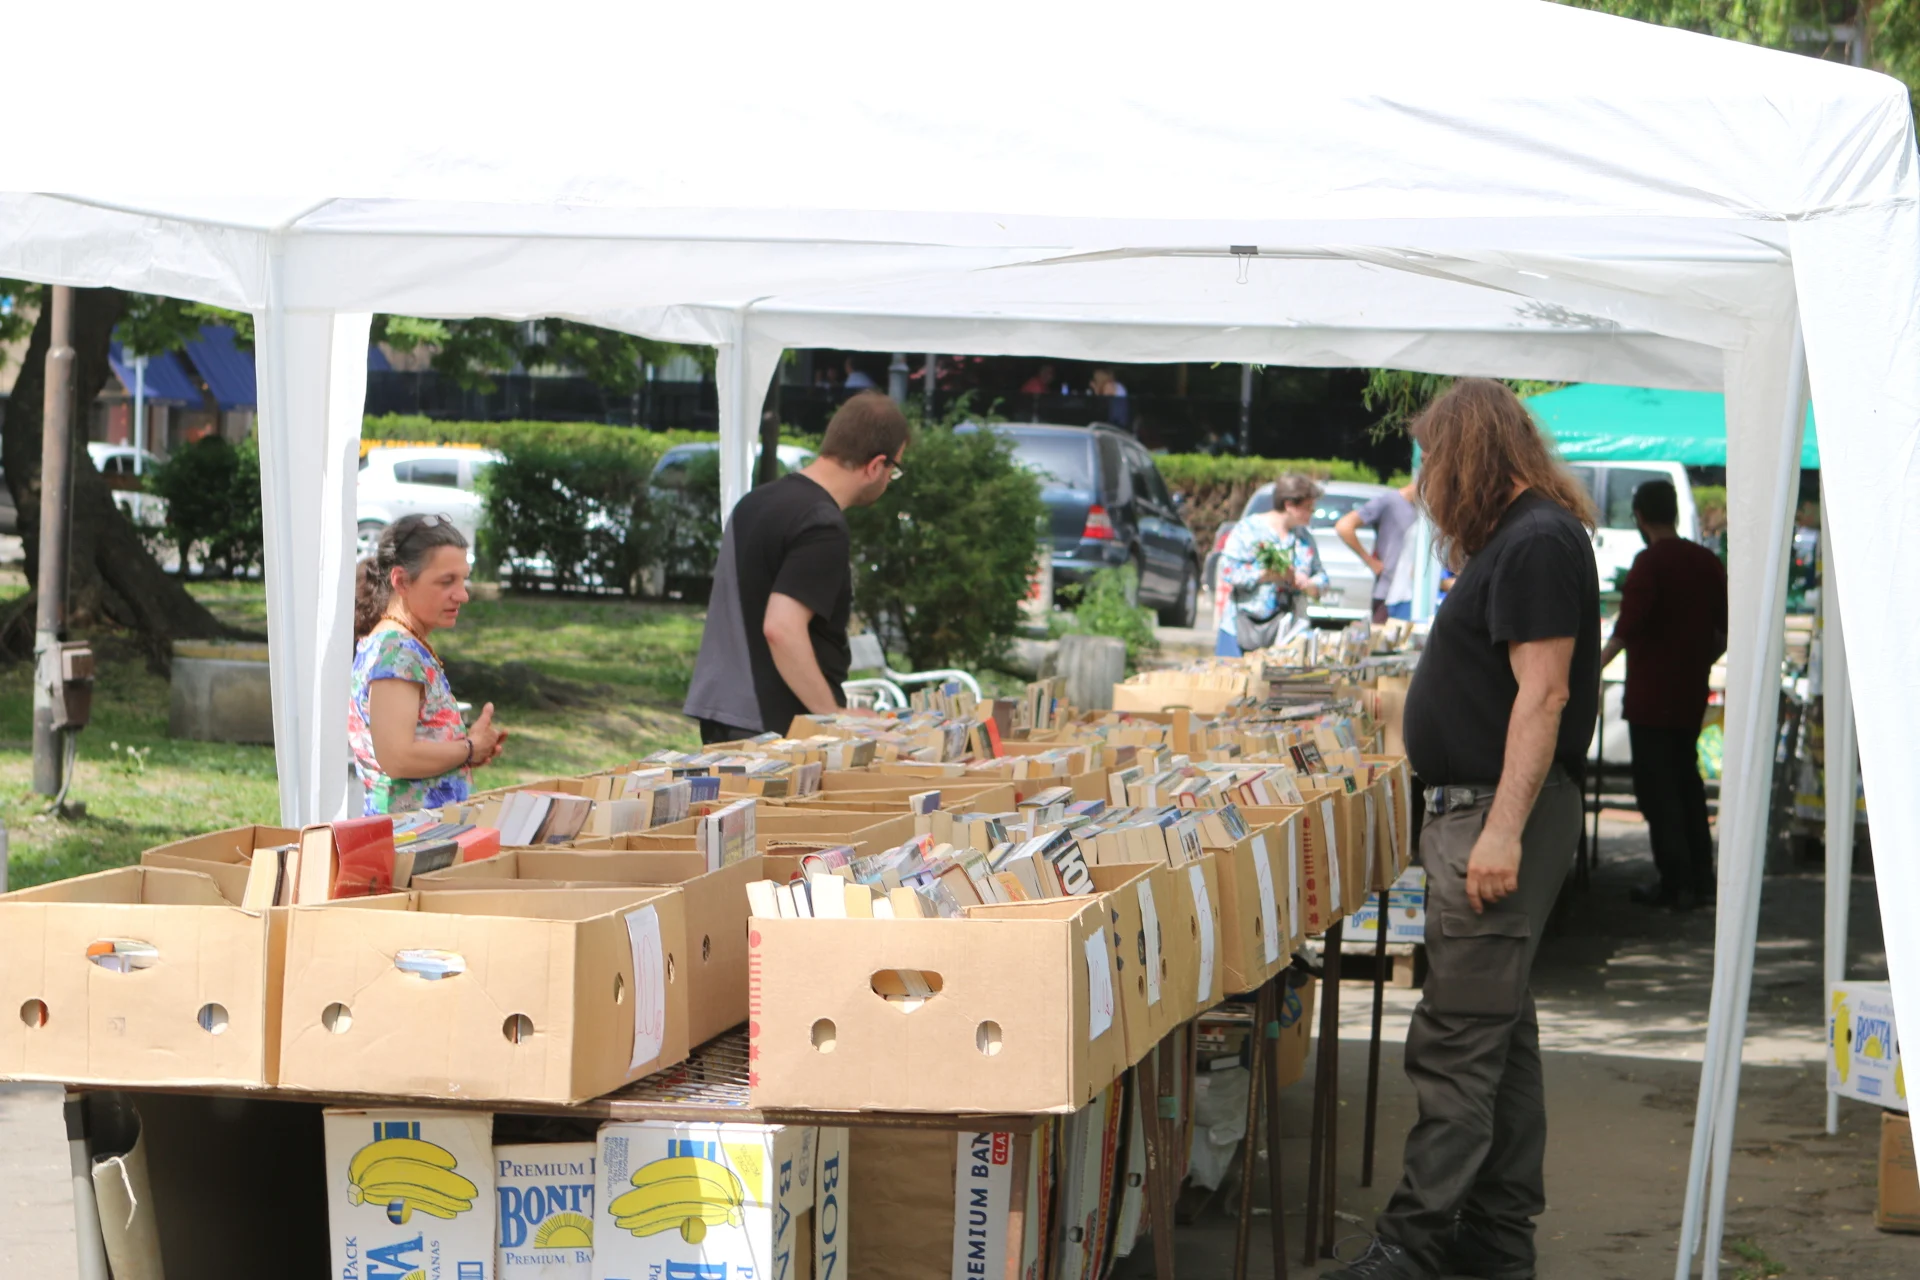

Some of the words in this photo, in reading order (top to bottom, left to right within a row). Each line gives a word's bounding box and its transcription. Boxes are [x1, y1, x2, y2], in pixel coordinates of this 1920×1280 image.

[1855, 1015, 1891, 1060] BONITA
[995, 1131, 1007, 1162] CLA
[499, 1159, 584, 1177] PREMIUM
[967, 1188, 989, 1280] EMIUM
[343, 1235, 359, 1280] PACK
[505, 1251, 566, 1265] PREMIUM
